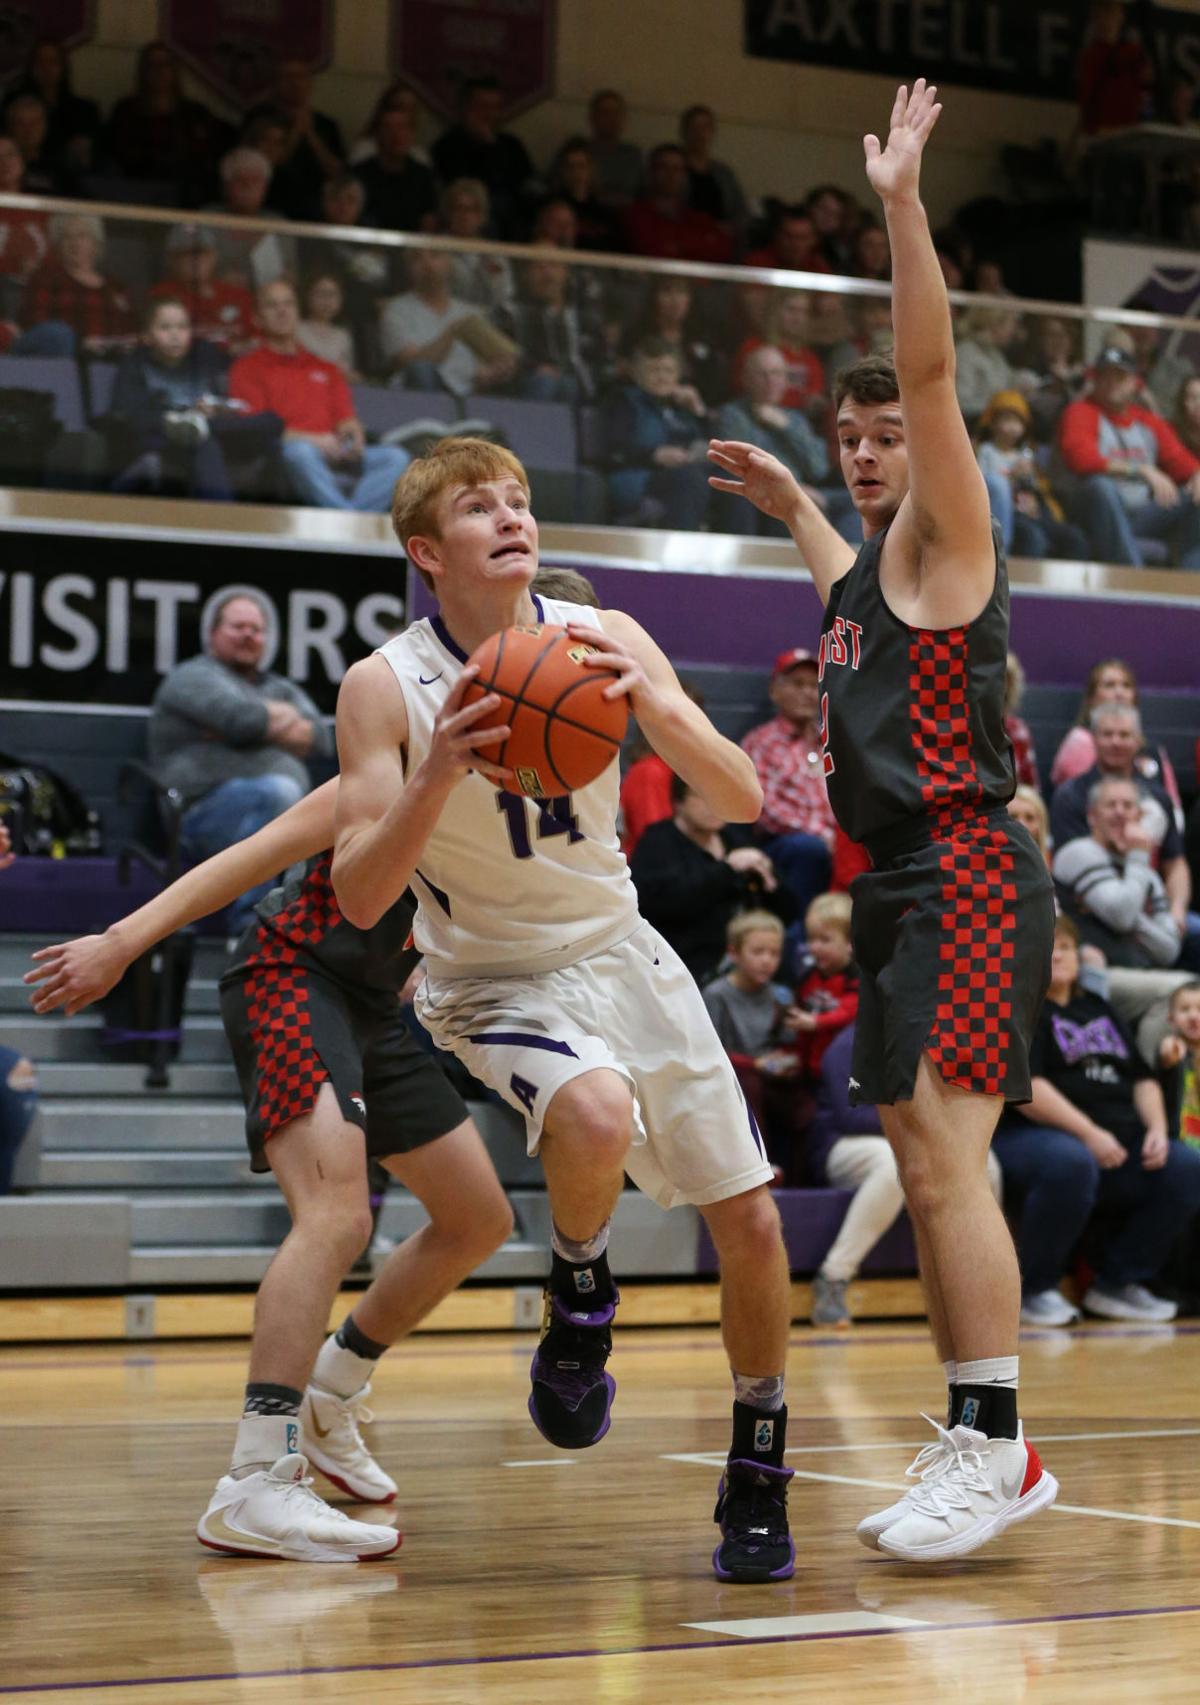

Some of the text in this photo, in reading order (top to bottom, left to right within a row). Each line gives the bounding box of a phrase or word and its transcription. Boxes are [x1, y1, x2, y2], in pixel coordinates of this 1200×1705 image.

[765, 0, 1016, 71] AXTELL
[0, 571, 401, 685] ISITORS
[495, 789, 586, 860] 14
